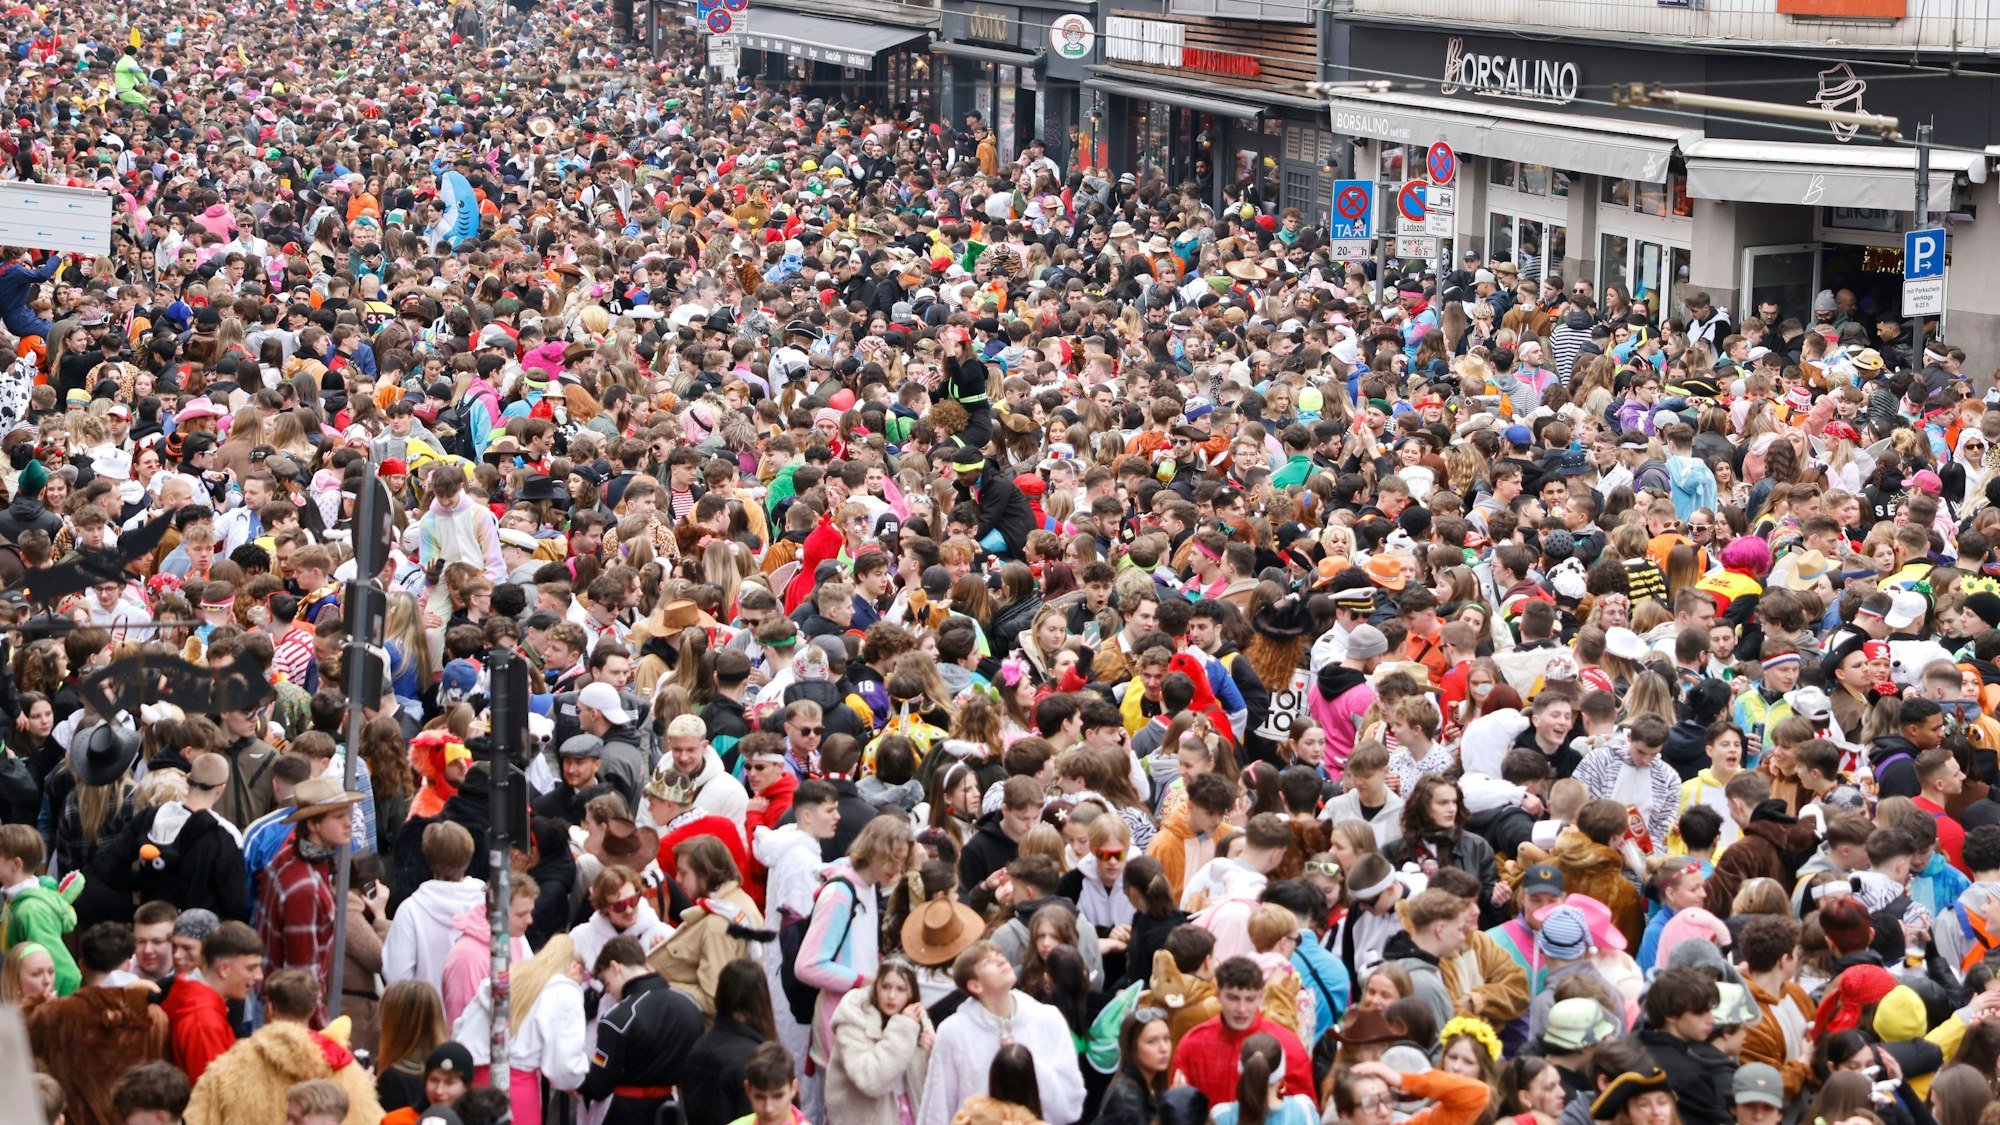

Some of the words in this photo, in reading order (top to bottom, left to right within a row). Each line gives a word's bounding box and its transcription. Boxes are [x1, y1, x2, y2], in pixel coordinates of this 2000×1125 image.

[1143, 20, 1185, 67] NAPOLI
[1202, 49, 1225, 72] PASTA
[1440, 36, 1579, 100] BORSALINO
[1336, 112, 1389, 136] BORSALINO
[1390, 128, 1399, 137] seit
[1335, 224, 1367, 238] TAXI
[1914, 236, 1936, 273] P
[1915, 285, 1940, 294] Parkschein
[367, 314, 386, 324] 33
[1875, 504, 1896, 517] SE
[885, 521, 898, 532] FBI
[858, 680, 875, 694] 18
[1264, 710, 1297, 732] TO
